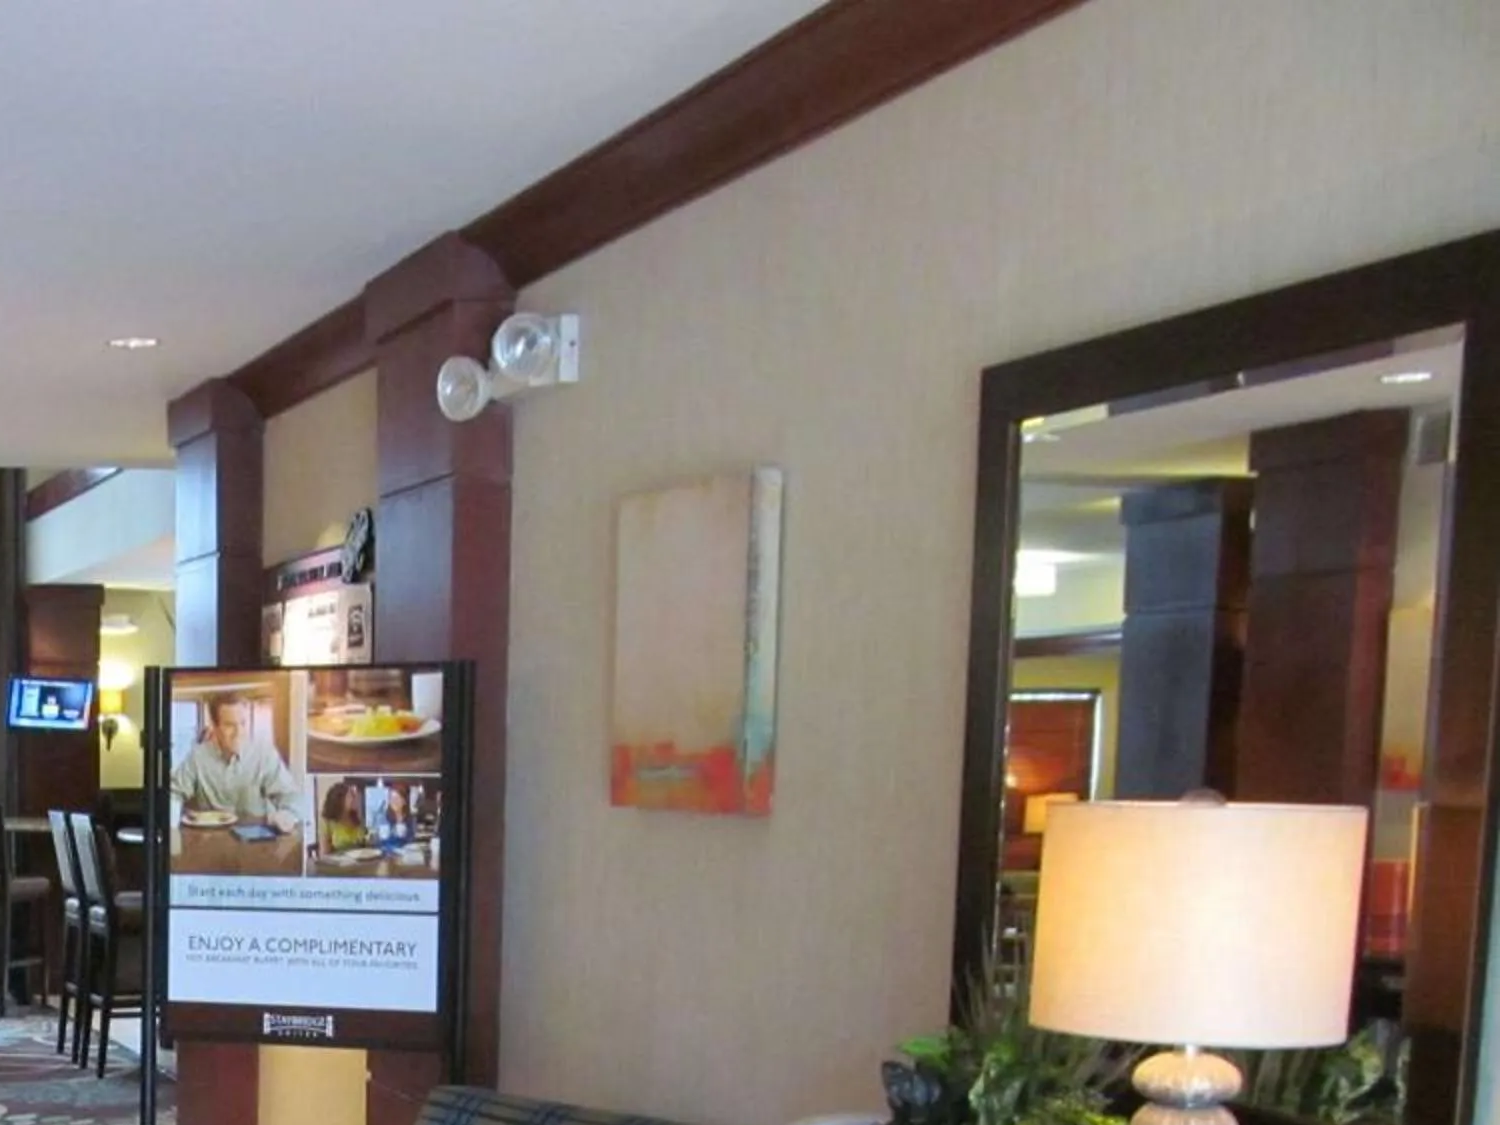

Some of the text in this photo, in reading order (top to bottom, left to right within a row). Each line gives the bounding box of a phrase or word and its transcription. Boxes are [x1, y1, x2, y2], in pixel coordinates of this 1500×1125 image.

[187, 884, 216, 898] Start
[218, 886, 245, 898] each
[248, 887, 268, 901] day
[270, 887, 296, 899] with
[299, 889, 363, 904] something
[188, 935, 418, 957] ENJOY A COMPLIMENTARY
